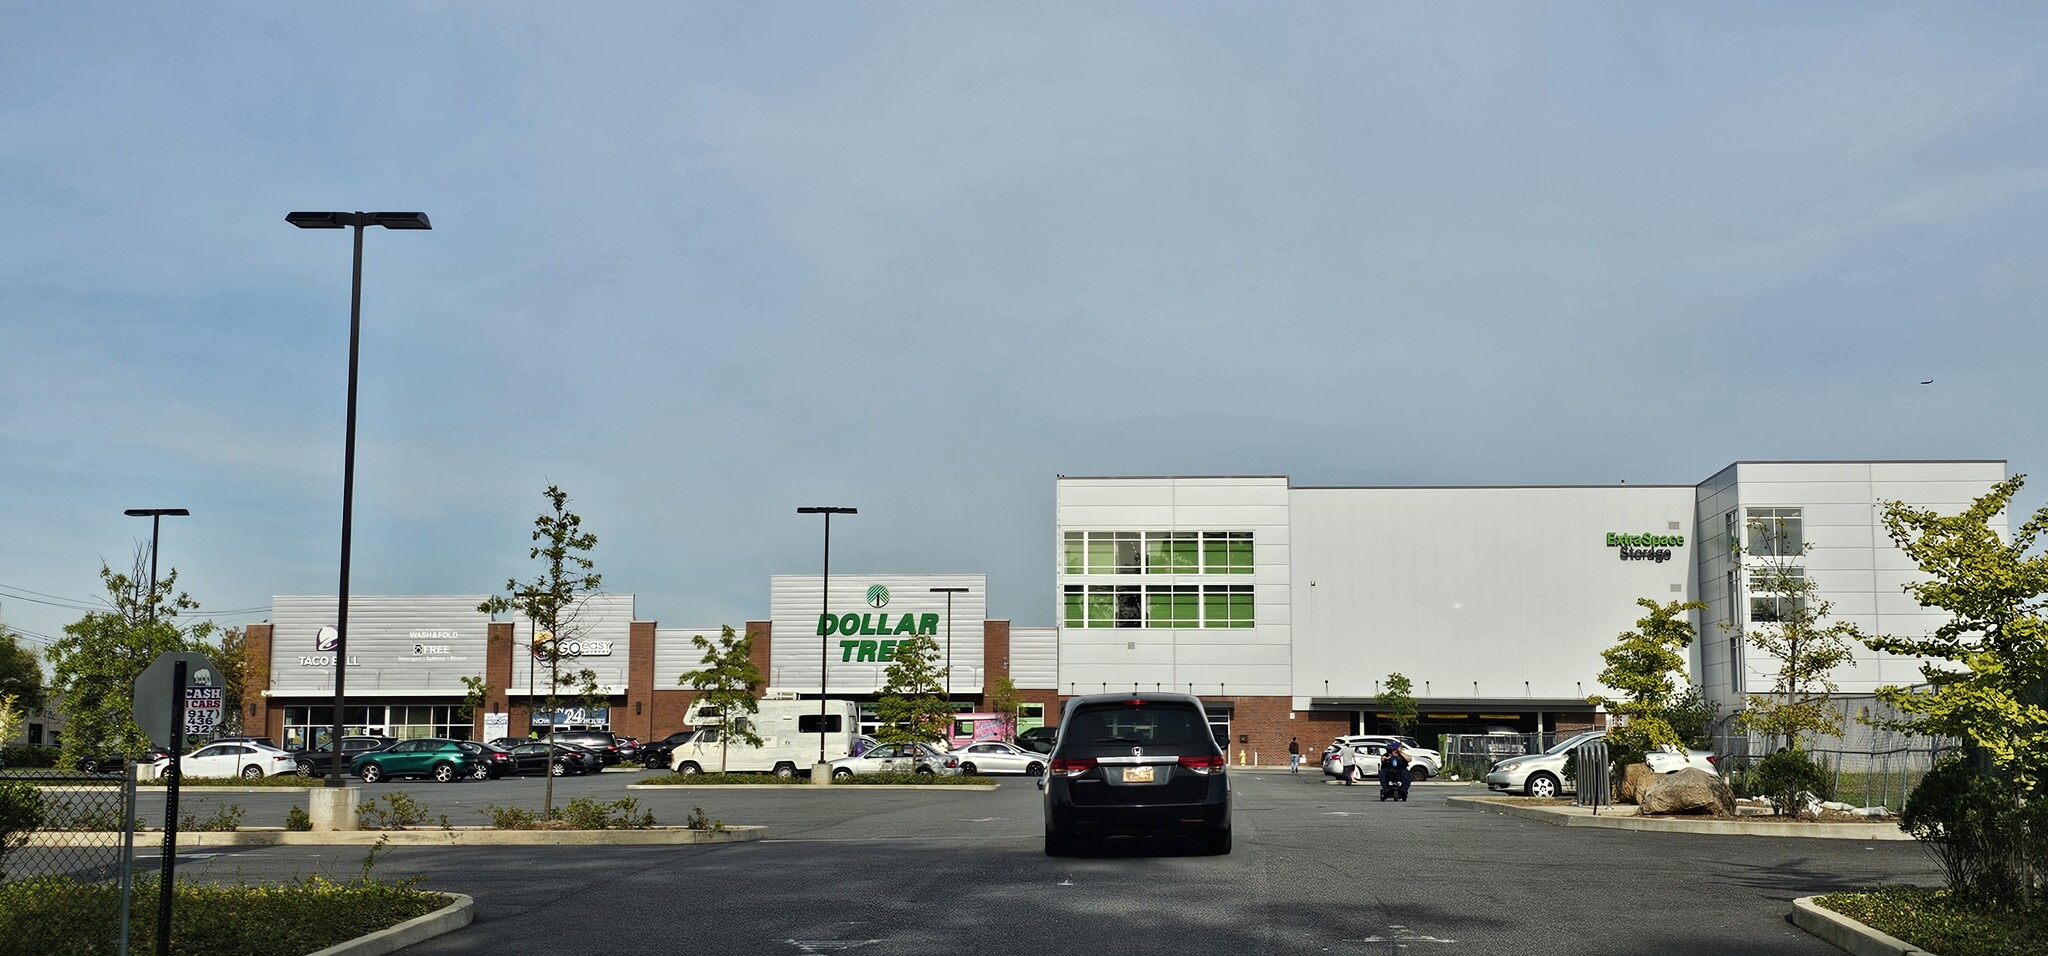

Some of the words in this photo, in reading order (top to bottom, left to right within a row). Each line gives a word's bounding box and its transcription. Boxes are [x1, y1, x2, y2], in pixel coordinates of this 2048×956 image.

[1619, 546, 1672, 563] Storage
[816, 613, 940, 636] DOLLAR
[423, 645, 451, 654] FREE
[557, 641, 581, 654] GO
[298, 656, 330, 666] TACO
[331, 656, 361, 666] BLL
[191, 700, 221, 708] CARS
[187, 717, 214, 725] 436
[562, 707, 586, 724] 24
